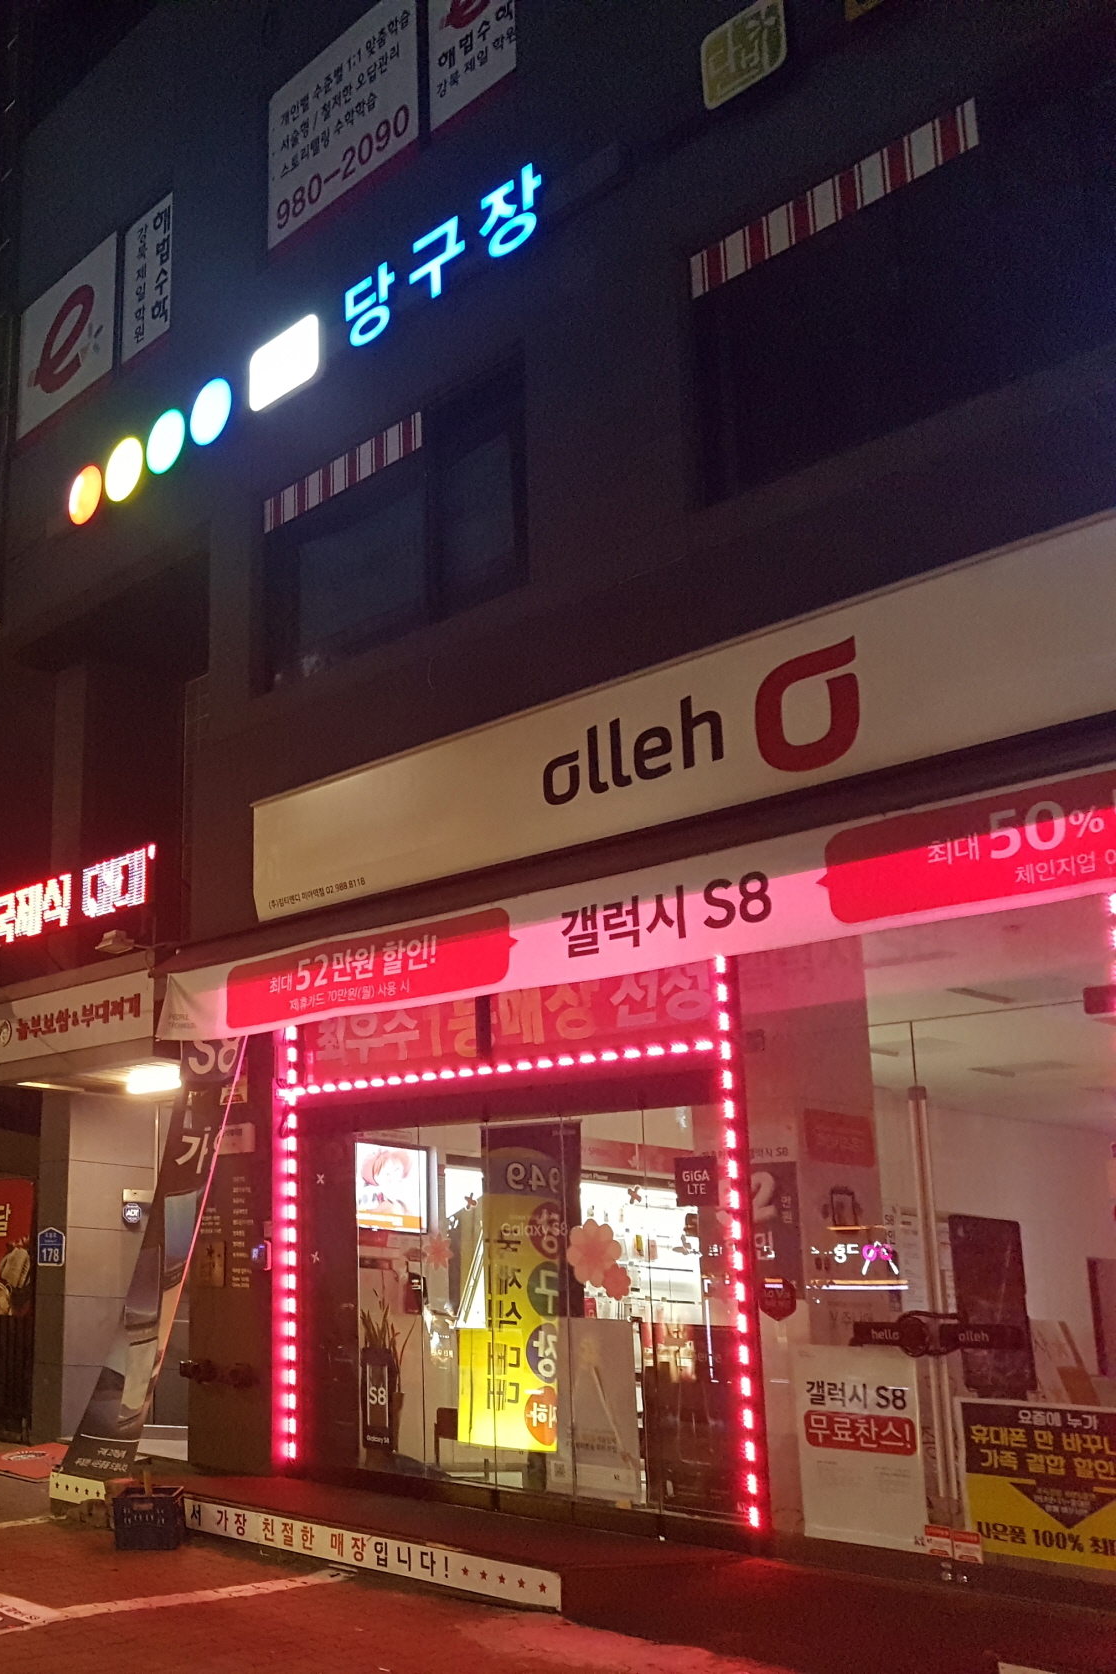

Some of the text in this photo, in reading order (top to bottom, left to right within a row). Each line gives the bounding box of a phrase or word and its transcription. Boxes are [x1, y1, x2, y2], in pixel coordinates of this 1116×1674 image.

[277, 104, 410, 229] 980-2090
[345, 162, 542, 347] 당구장
[543, 694, 724, 806] olleh
[927, 800, 1104, 865] 최대 50%
[1015, 851, 1097, 885] 체인지업
[561, 871, 773, 959] 갤럭시 S8
[269, 934, 437, 994] 최대 52만원 할인!
[377, 981, 397, 997] 사용
[400, 978, 410, 993] 시
[317, 1006, 420, 1066] 최우수
[609, 958, 714, 1027] 선정
[687, 1184, 707, 1195] LTE
[500, 1221, 569, 1240] Galaxy S8
[41, 1247, 60, 1263] 178
[368, 1386, 387, 1406] S8
[806, 1379, 907, 1411] 갤럭시 S8
[808, 1413, 912, 1449] 무료찬스!
[970, 1423, 1027, 1449] 휴대폰
[1034, 1429, 1054, 1451] 만
[1066, 1412, 1099, 1430] 누가
[979, 1448, 1018, 1471] 가족
[1026, 1452, 1066, 1476] 결합
[215, 1509, 247, 1537] 가장
[261, 1517, 315, 1551] 친절한
[330, 1531, 450, 1579] 매장입니다!
[1032, 1528, 1084, 1553] 100%
